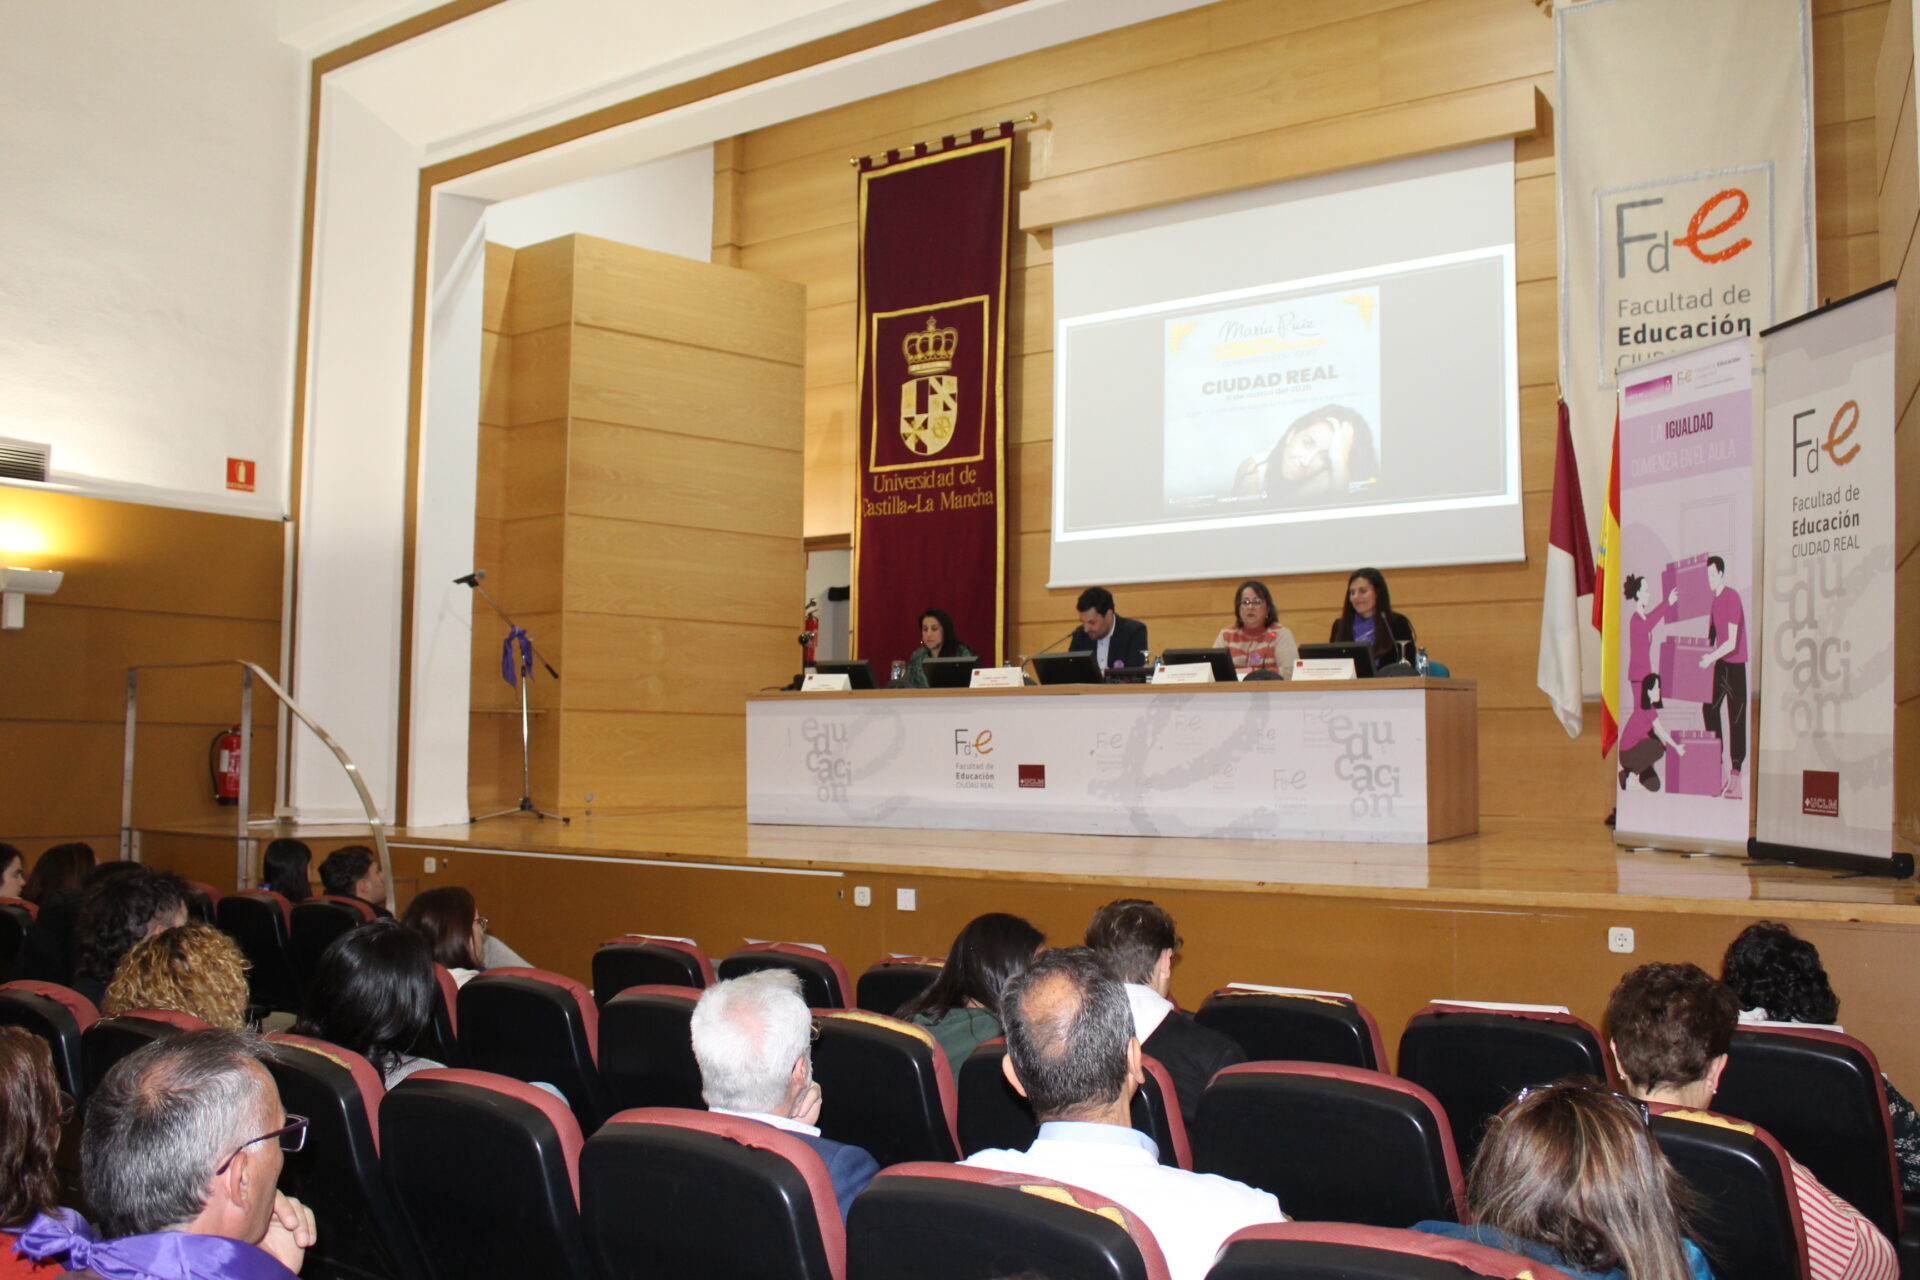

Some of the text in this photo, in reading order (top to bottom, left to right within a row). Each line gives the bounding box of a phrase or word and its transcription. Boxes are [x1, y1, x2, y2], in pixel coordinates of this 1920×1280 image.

[1618, 284, 1751, 318] Facultad de
[1618, 313, 1751, 346] Educación
[1201, 364, 1339, 396] CIUDAD REAL
[1665, 411, 1714, 440] IGUALDAD
[873, 465, 977, 493] Universidad de
[940, 487, 994, 511] Mancha
[1792, 484, 1860, 512] Facultad de
[1792, 509, 1860, 537] Educación
[1791, 535, 1860, 559] CIUDAD REAL
[955, 762, 994, 770] Facultad de
[955, 772, 995, 780] Educación
